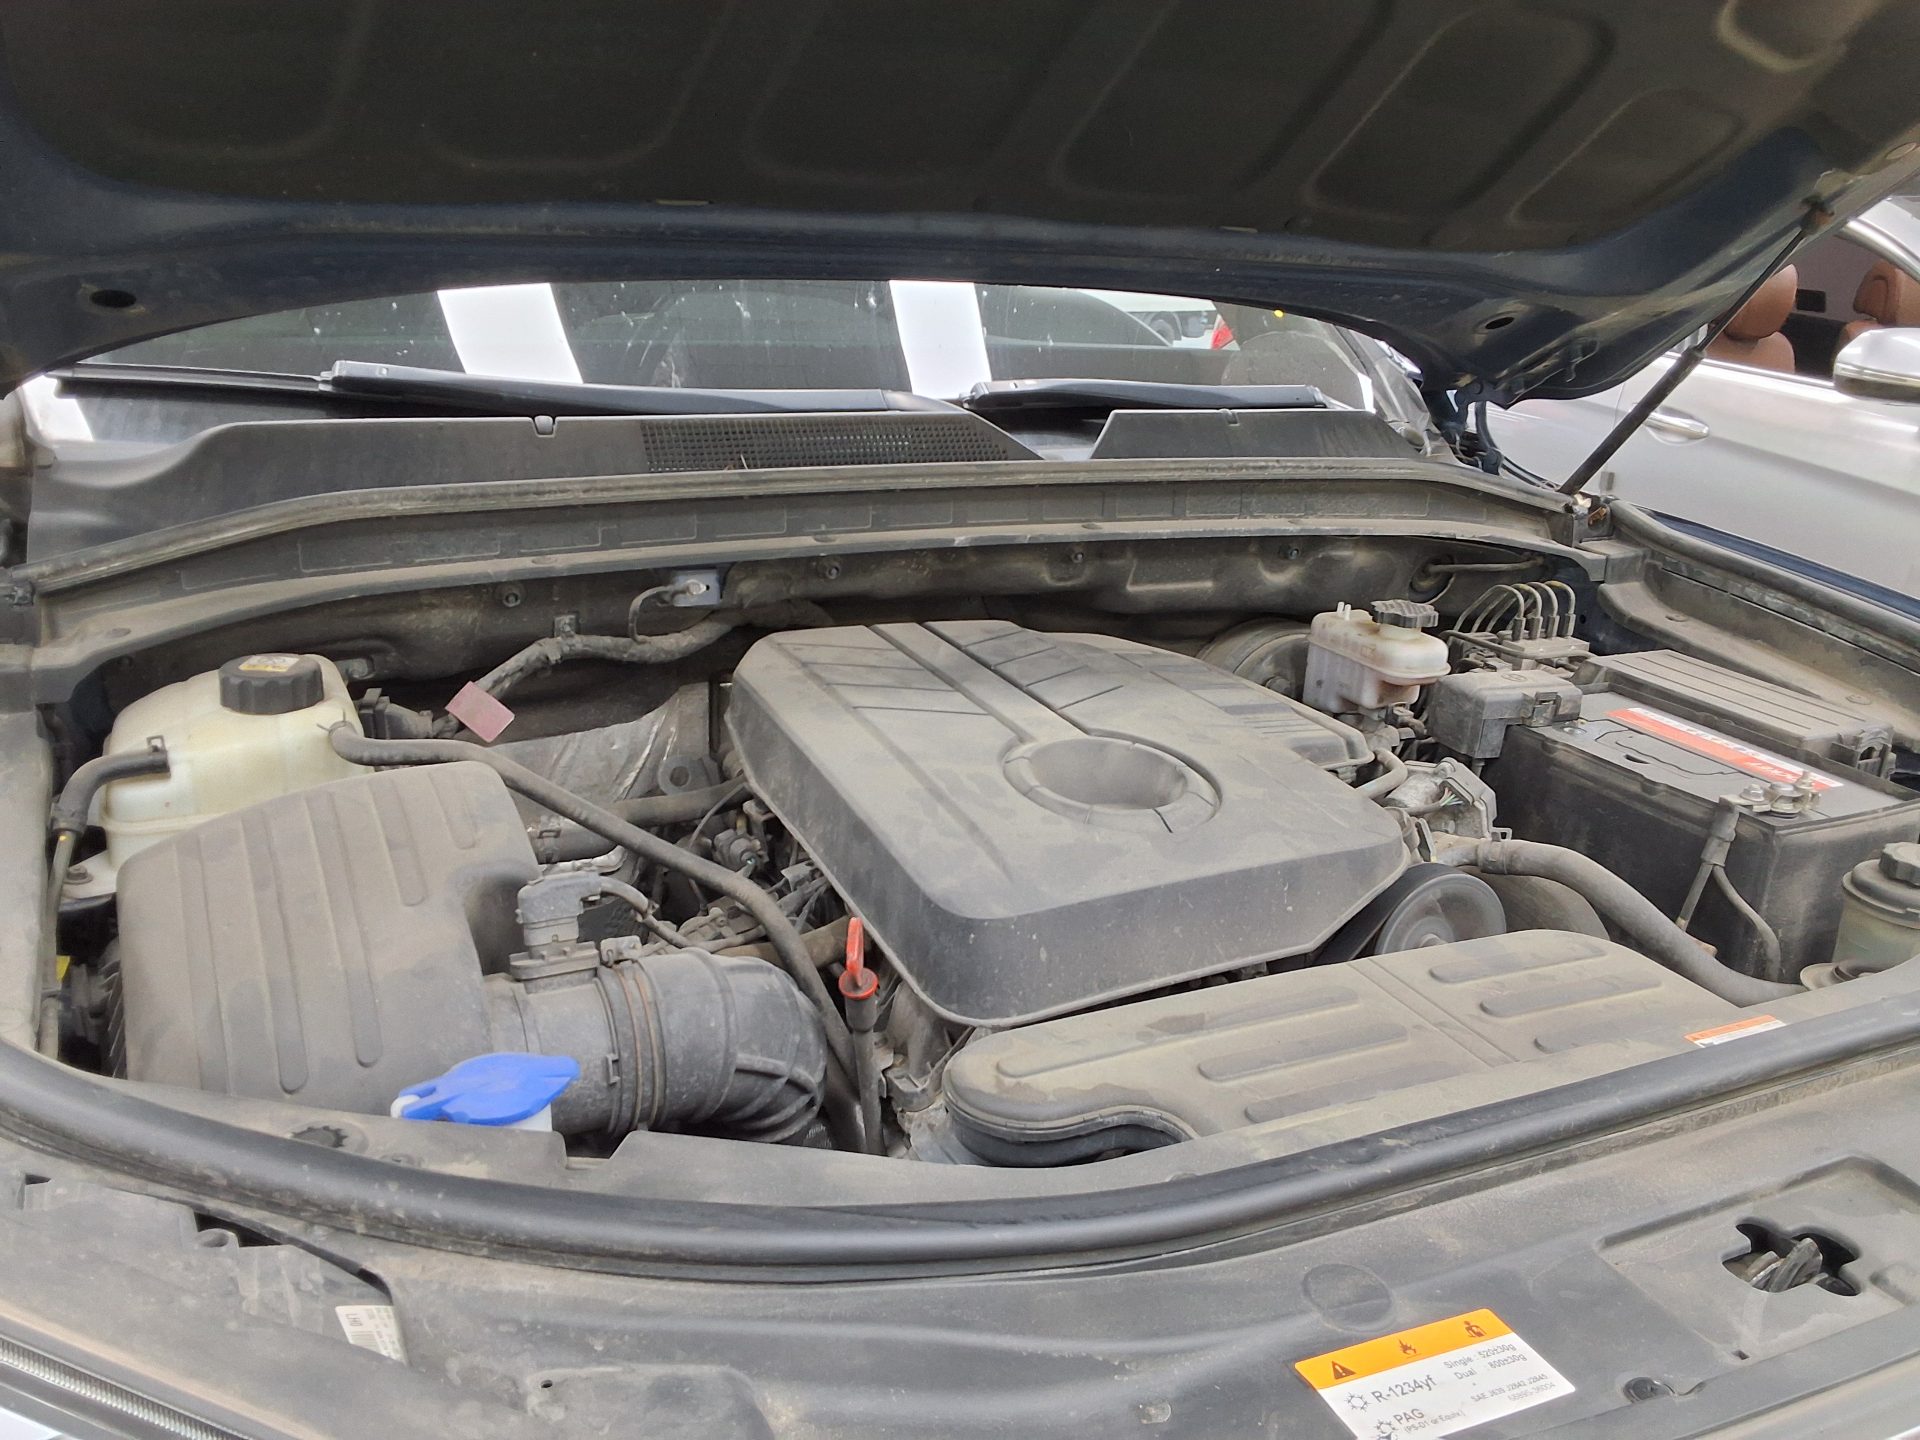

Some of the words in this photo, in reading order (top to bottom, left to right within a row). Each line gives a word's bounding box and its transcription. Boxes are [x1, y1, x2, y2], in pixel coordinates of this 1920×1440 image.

[1443, 1356, 1474, 1369] Single
[1454, 1368, 1477, 1380] Dual
[1371, 1374, 1437, 1403] R-1234yf
[1393, 1408, 1425, 1425] PAG
